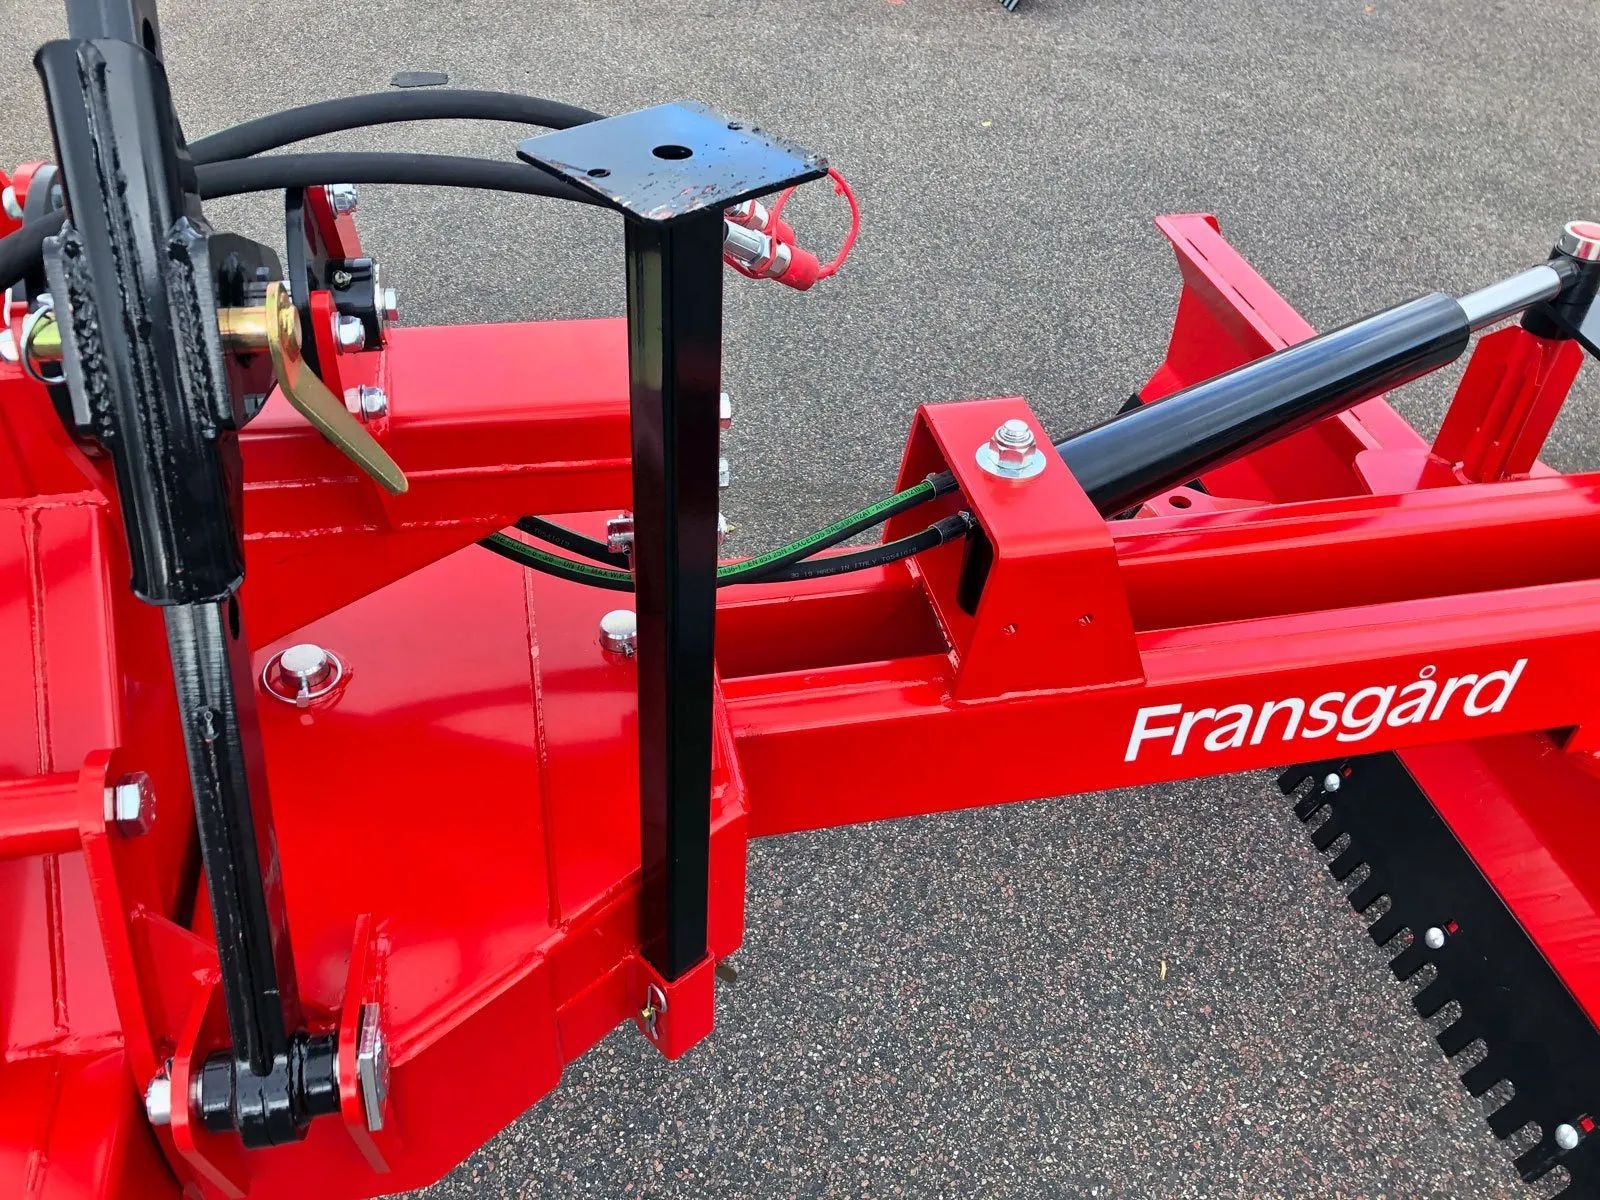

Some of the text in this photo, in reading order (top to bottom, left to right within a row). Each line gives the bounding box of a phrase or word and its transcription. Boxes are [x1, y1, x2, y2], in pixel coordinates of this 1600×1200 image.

[792, 531, 825, 550] EXCEEDS
[816, 567, 837, 576] MADE
[1125, 659, 1528, 761] Fransgård
